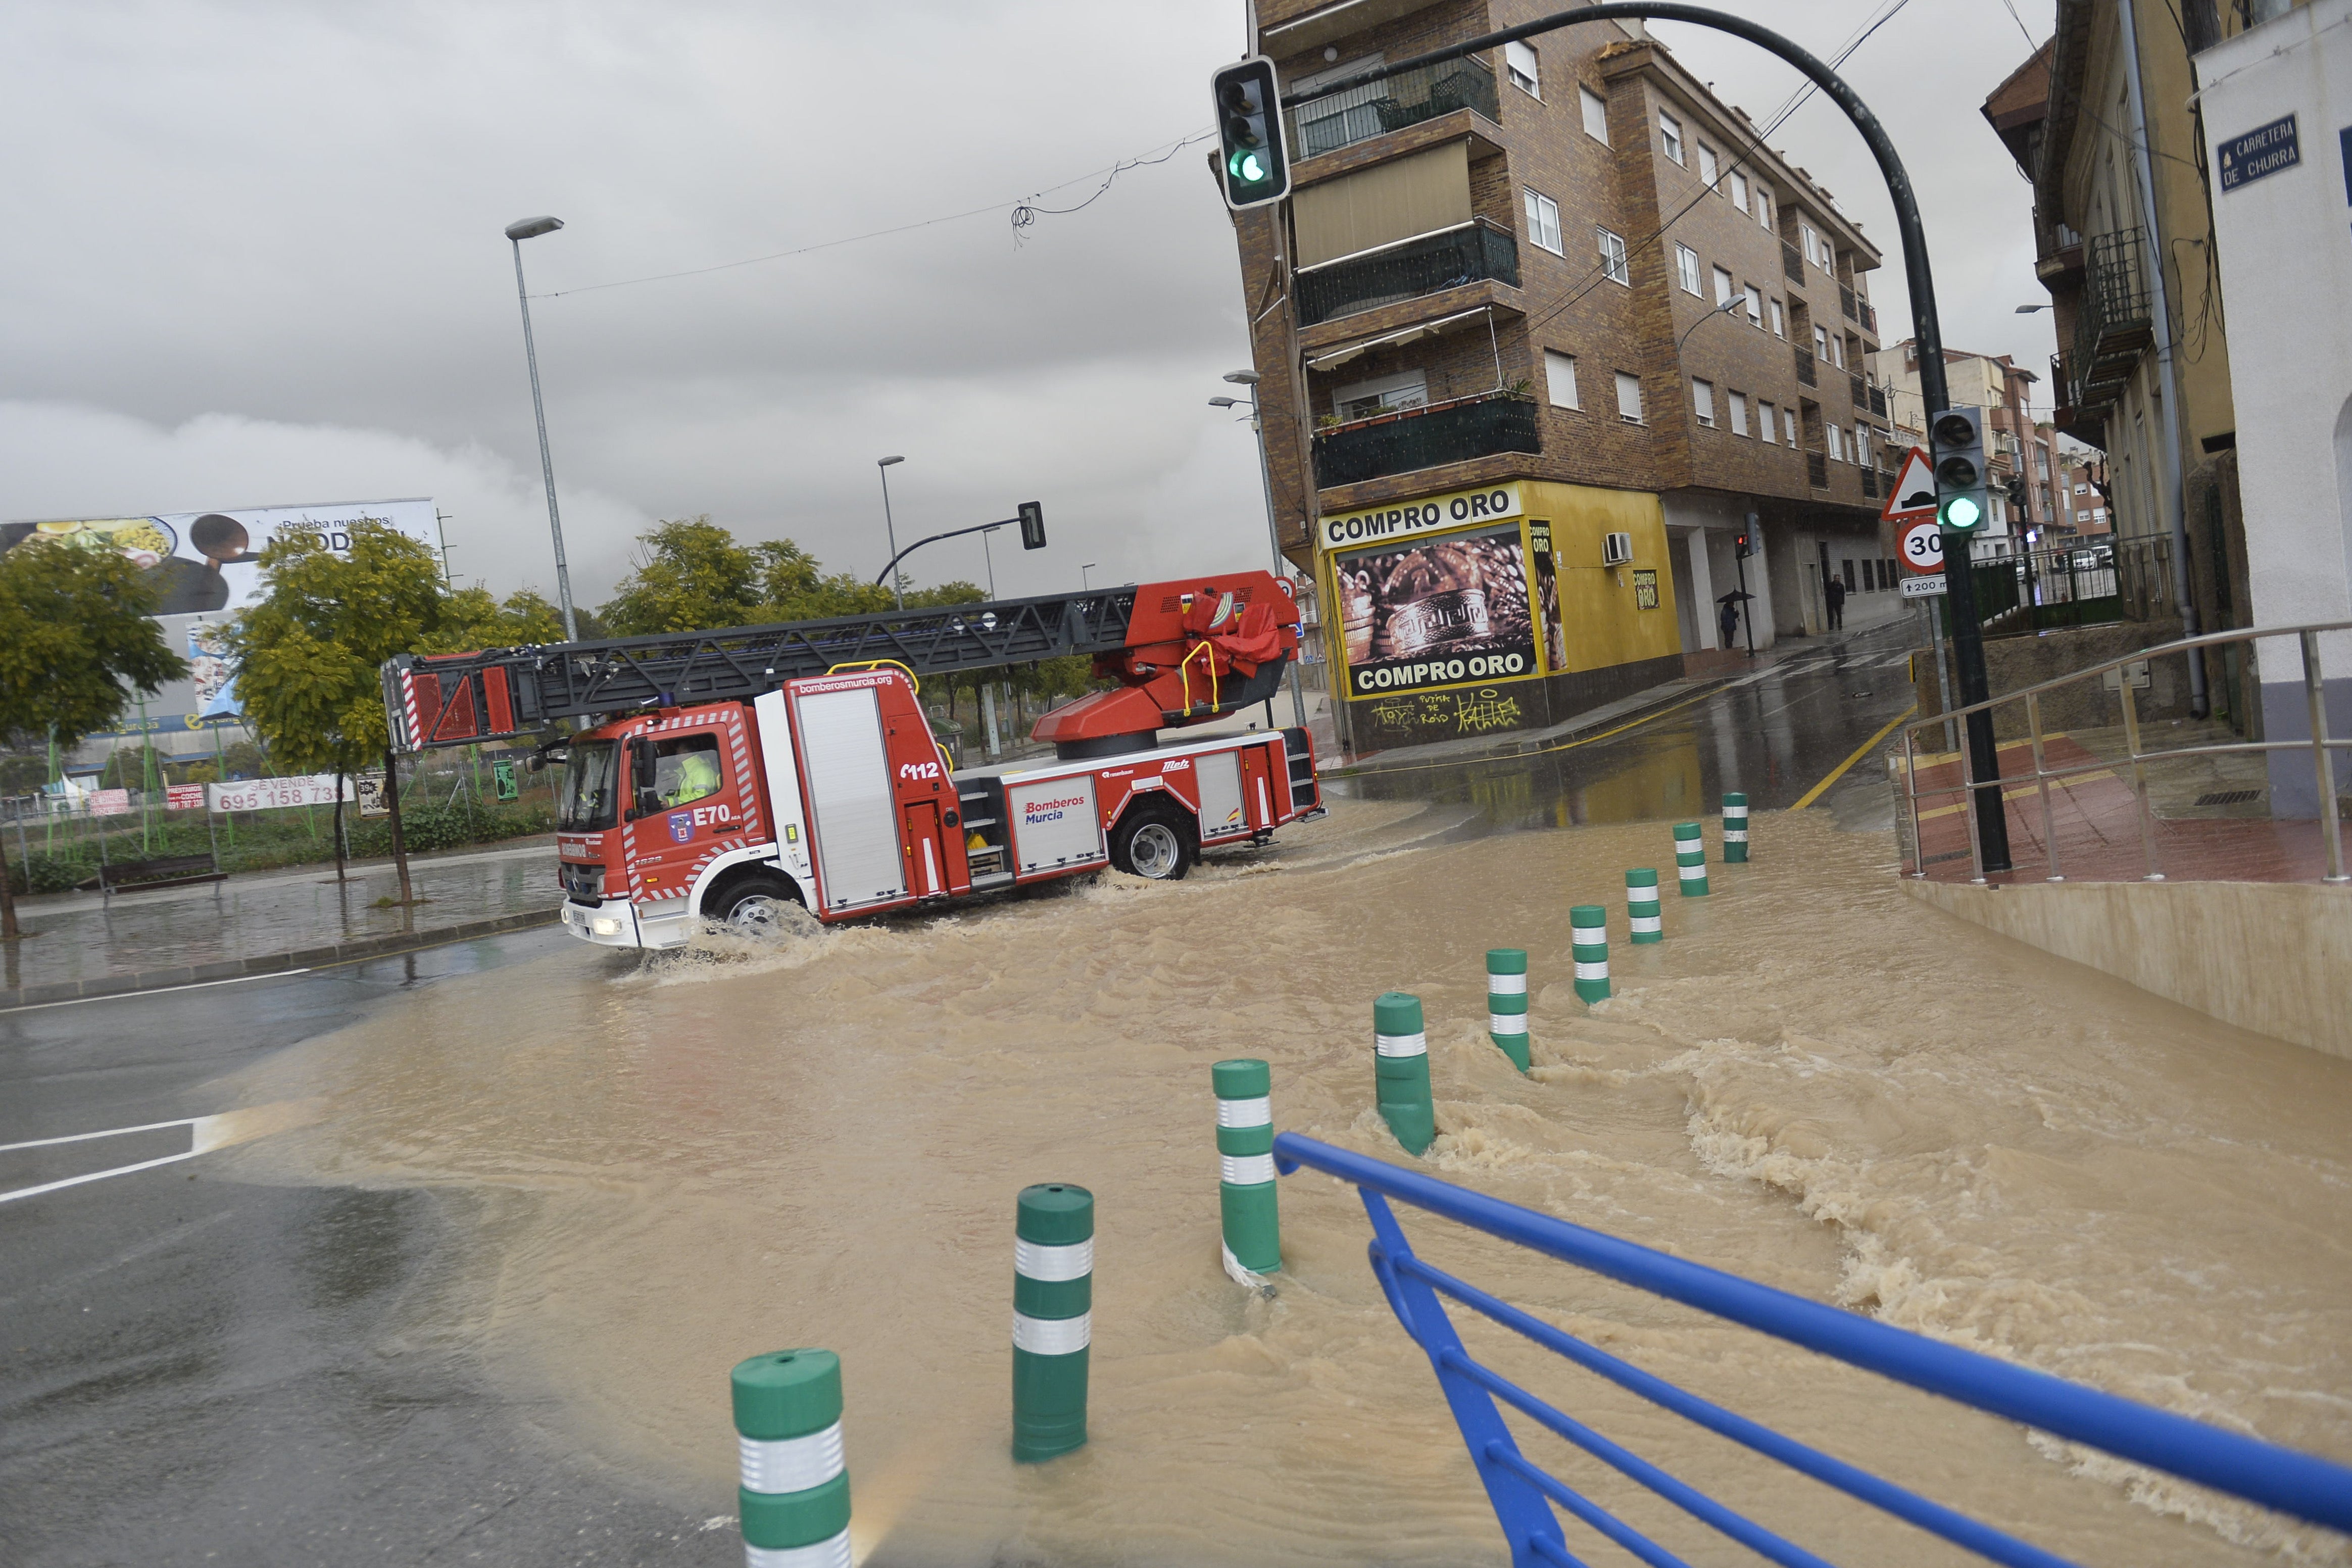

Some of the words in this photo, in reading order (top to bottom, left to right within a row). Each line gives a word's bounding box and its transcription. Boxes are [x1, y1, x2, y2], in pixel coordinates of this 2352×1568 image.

[2237, 121, 2293, 157] CARRETERA
[2224, 168, 2239, 186] DE
[2248, 145, 2296, 176] CHURRA
[279, 519, 329, 528] Prueba
[334, 516, 389, 527] nuesos
[1328, 503, 1440, 542] COMPRO
[1450, 489, 1509, 520] ORO
[1529, 526, 1550, 536] COMPRO
[1533, 538, 1549, 553] ORO
[1910, 533, 1942, 556] 30
[1634, 572, 1655, 586] COMPRO
[1915, 581, 1936, 591] 200
[1638, 588, 1655, 606] ORO
[1358, 659, 1465, 689] COMPRO
[1468, 653, 1524, 676] ORO
[800, 675, 892, 694] bomberosmurcia.org
[908, 762, 939, 780] 112
[1162, 759, 1189, 771] Metz
[251, 779, 267, 791] SE
[271, 777, 314, 789] VENDE
[220, 793, 258, 810] 695
[267, 789, 302, 806] 158
[1026, 797, 1084, 814] Bomberos
[693, 804, 730, 826] E70
[1025, 810, 1063, 825] Murcia
